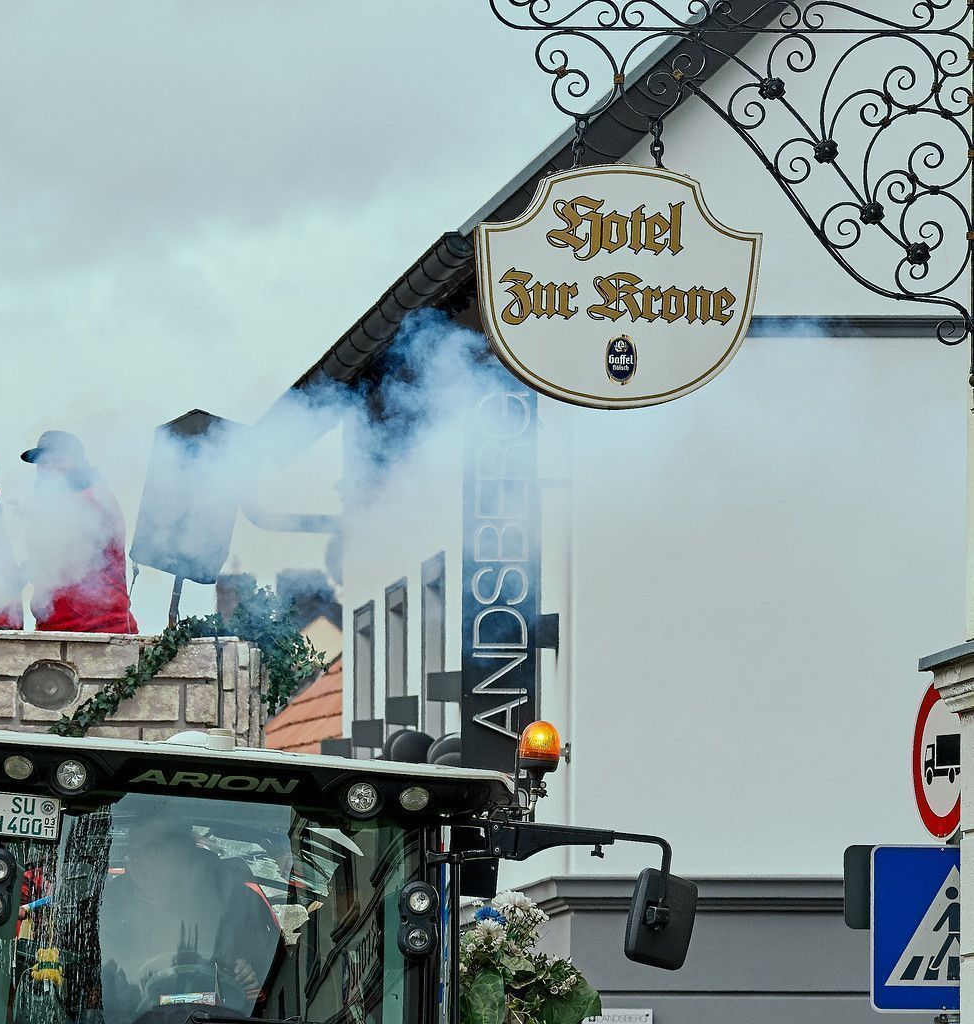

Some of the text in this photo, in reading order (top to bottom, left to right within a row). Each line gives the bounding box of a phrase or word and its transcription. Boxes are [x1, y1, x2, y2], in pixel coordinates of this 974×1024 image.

[546, 195, 685, 261] Hotel
[498, 267, 737, 326] Zur Krone
[608, 354, 634, 365] Gaffel
[471, 391, 531, 778] ANDSBERG
[128, 769, 300, 794] ARION
[11, 796, 36, 816] SU
[7, 816, 43, 836] 400
